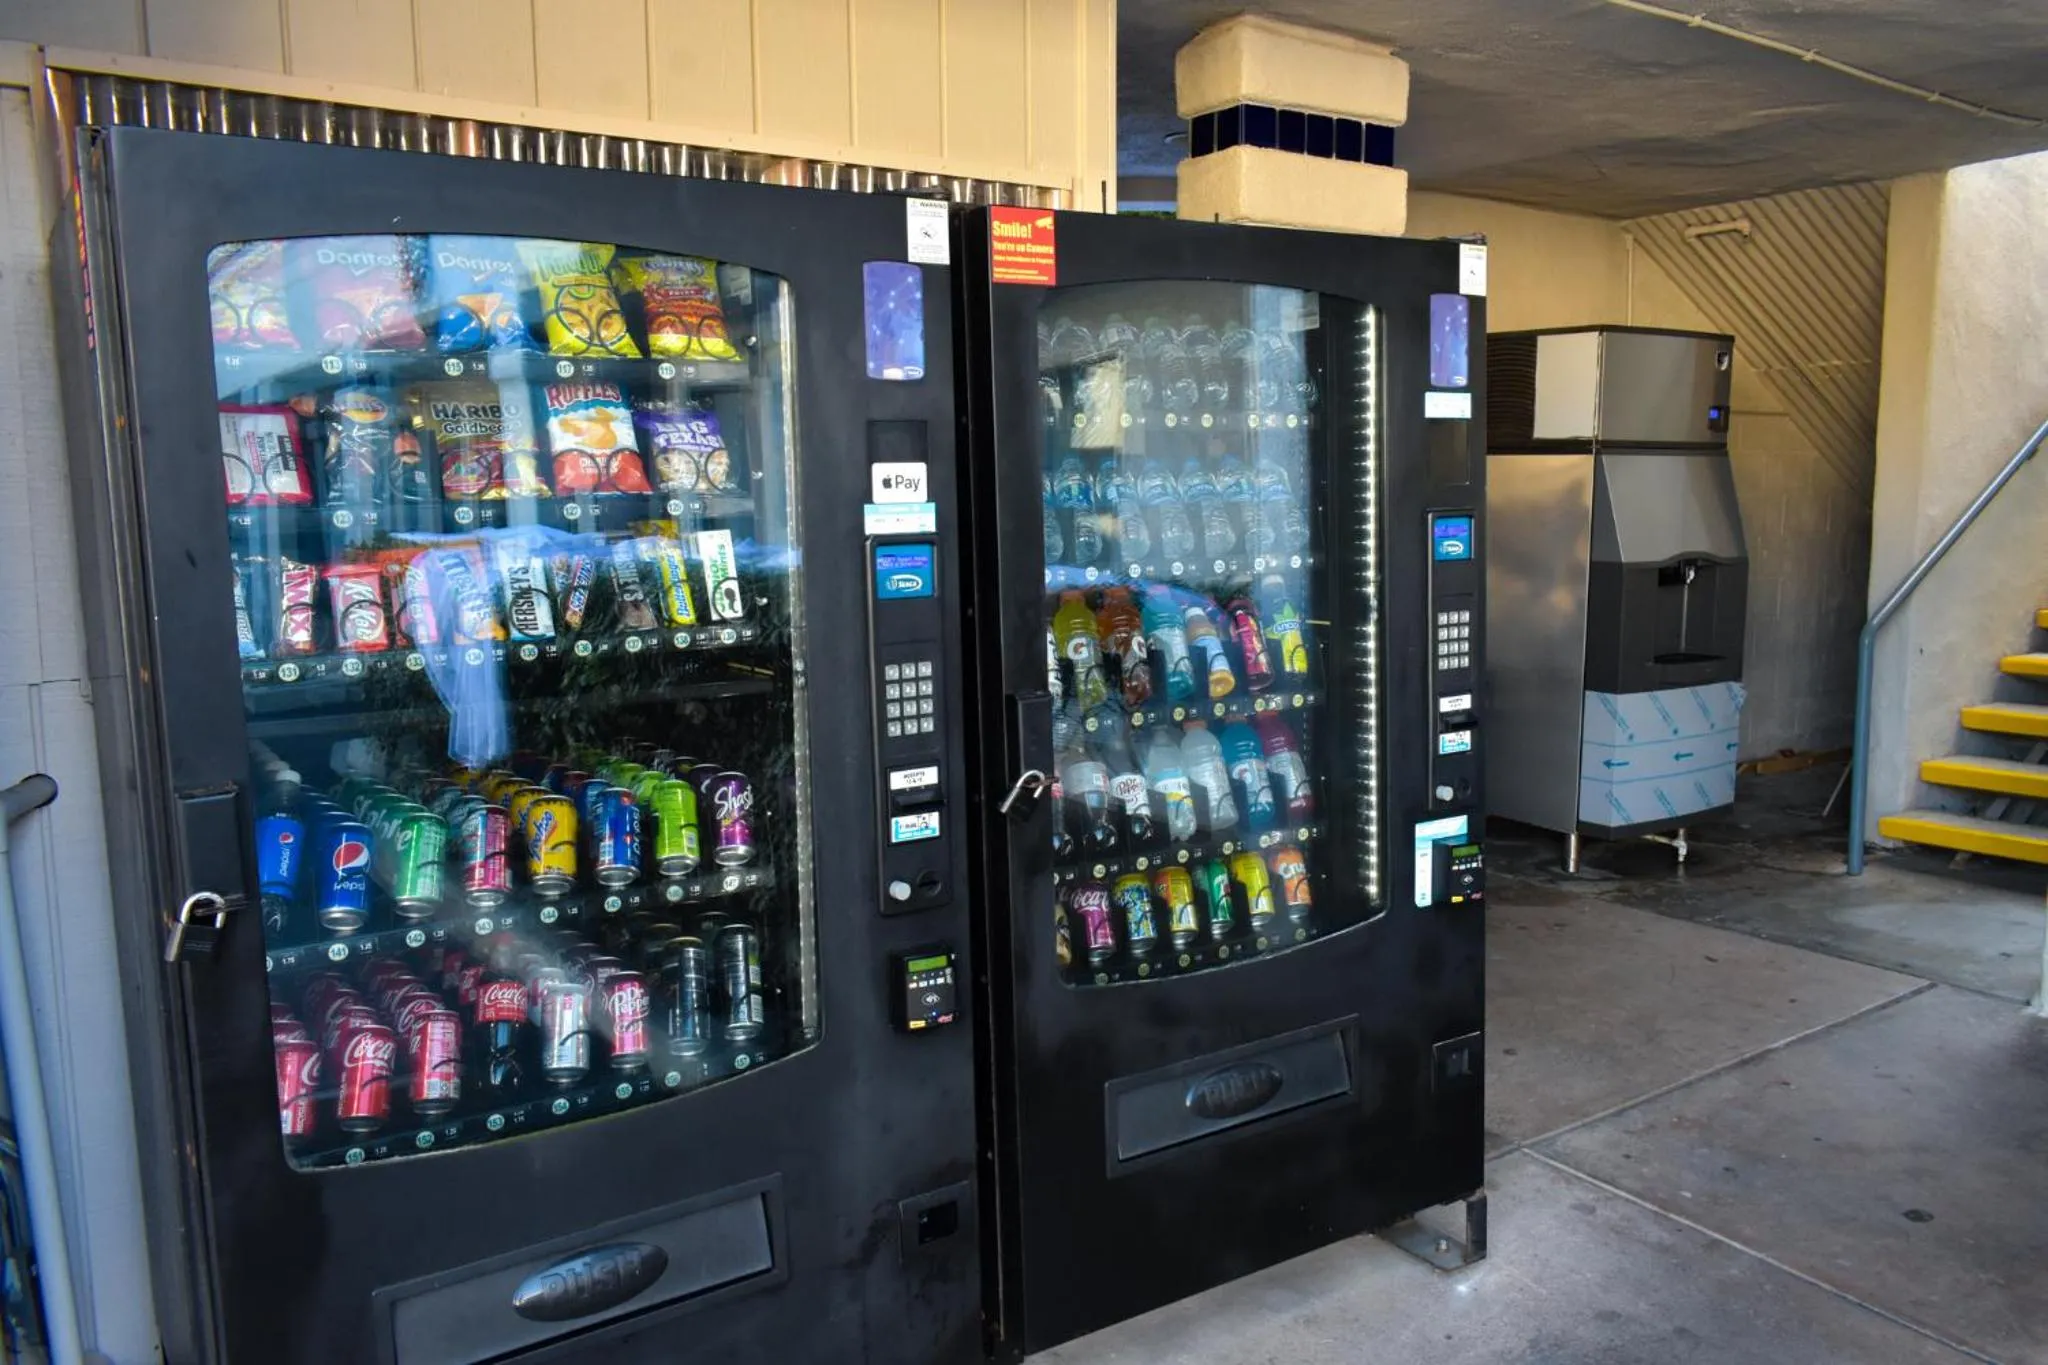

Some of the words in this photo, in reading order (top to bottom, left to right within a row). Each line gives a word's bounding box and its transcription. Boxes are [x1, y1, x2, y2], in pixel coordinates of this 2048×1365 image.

[992, 220, 1032, 239] Smile!
[316, 249, 404, 268] Doritos
[437, 252, 515, 274] Doritos
[544, 382, 622, 410] RUFFLES
[431, 403, 520, 420] HARIBO
[654, 432, 721, 449] TEXAS
[895, 474, 921, 492] Pay
[718, 544, 730, 578] Mints
[509, 567, 539, 632] HERSHEY'S
[1067, 637, 1090, 660] G
[279, 847, 291, 878] pepsi
[628, 987, 645, 1000] Dr
